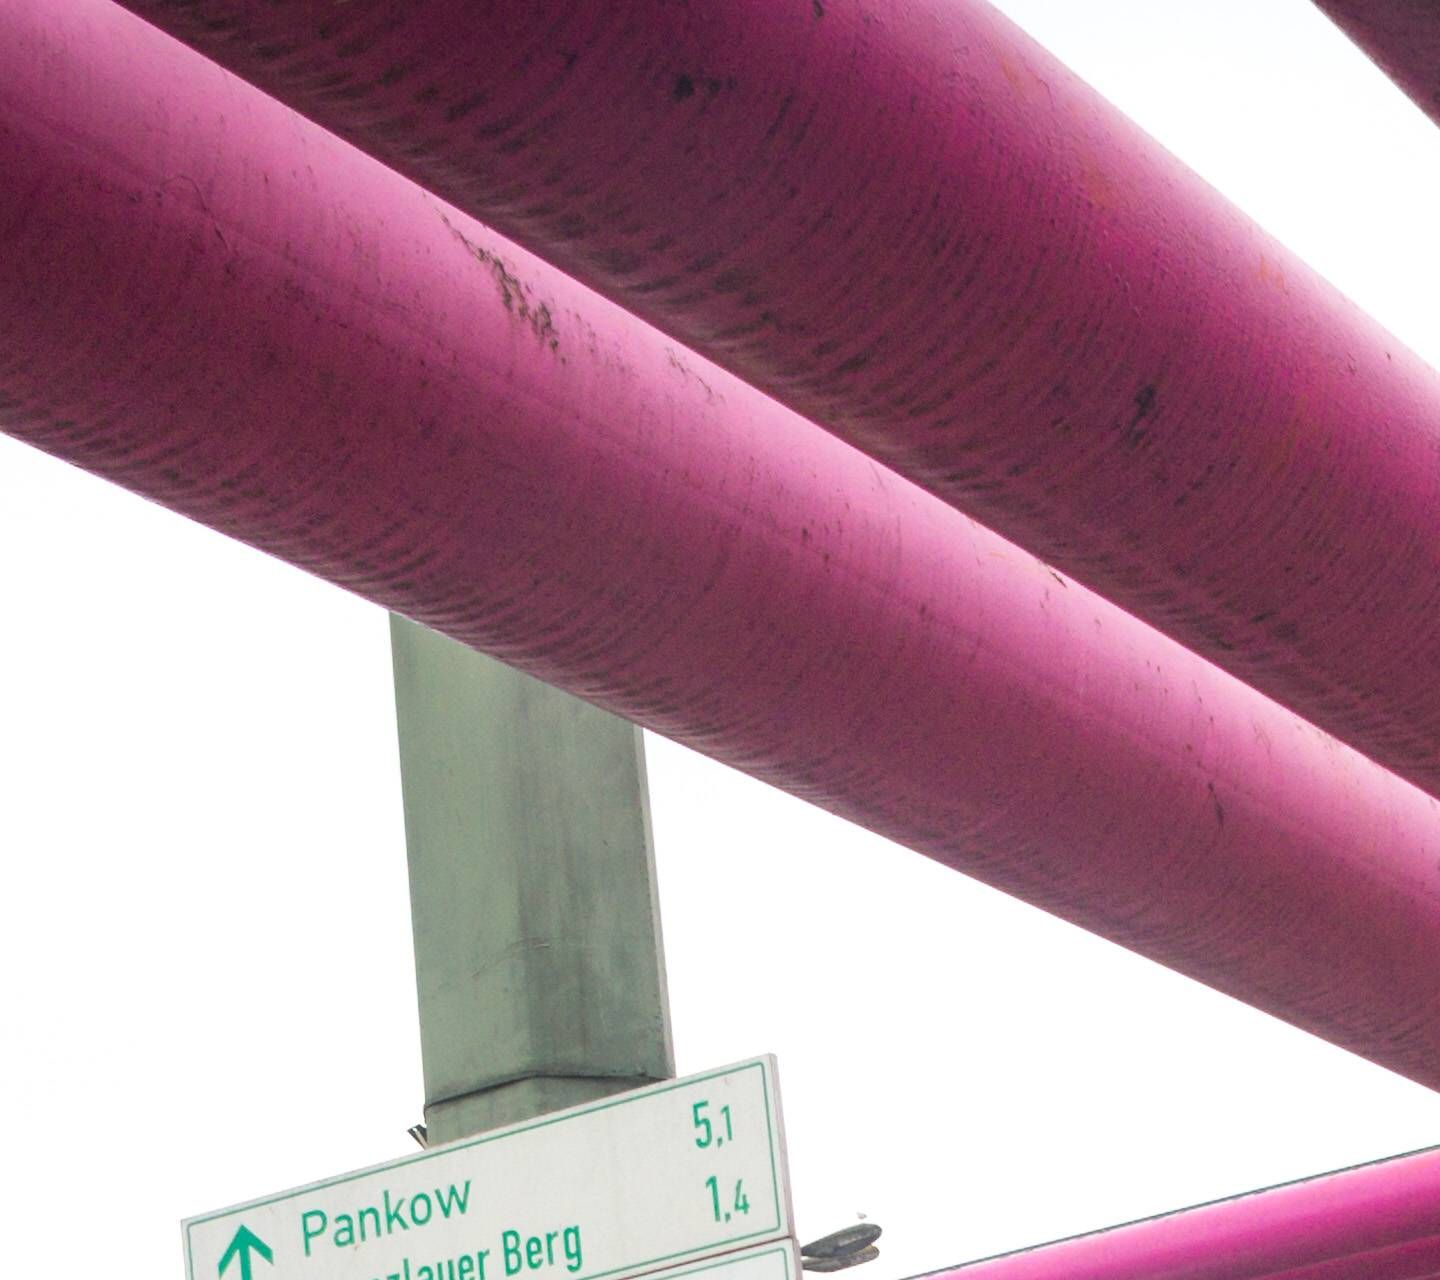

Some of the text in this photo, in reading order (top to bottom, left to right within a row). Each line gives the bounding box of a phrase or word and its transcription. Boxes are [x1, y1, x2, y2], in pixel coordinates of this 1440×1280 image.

[693, 1100, 733, 1149] 5,1
[301, 1180, 472, 1257] Pankow
[705, 1176, 750, 1223] 1,4
[502, 1224, 583, 1274] Berg
